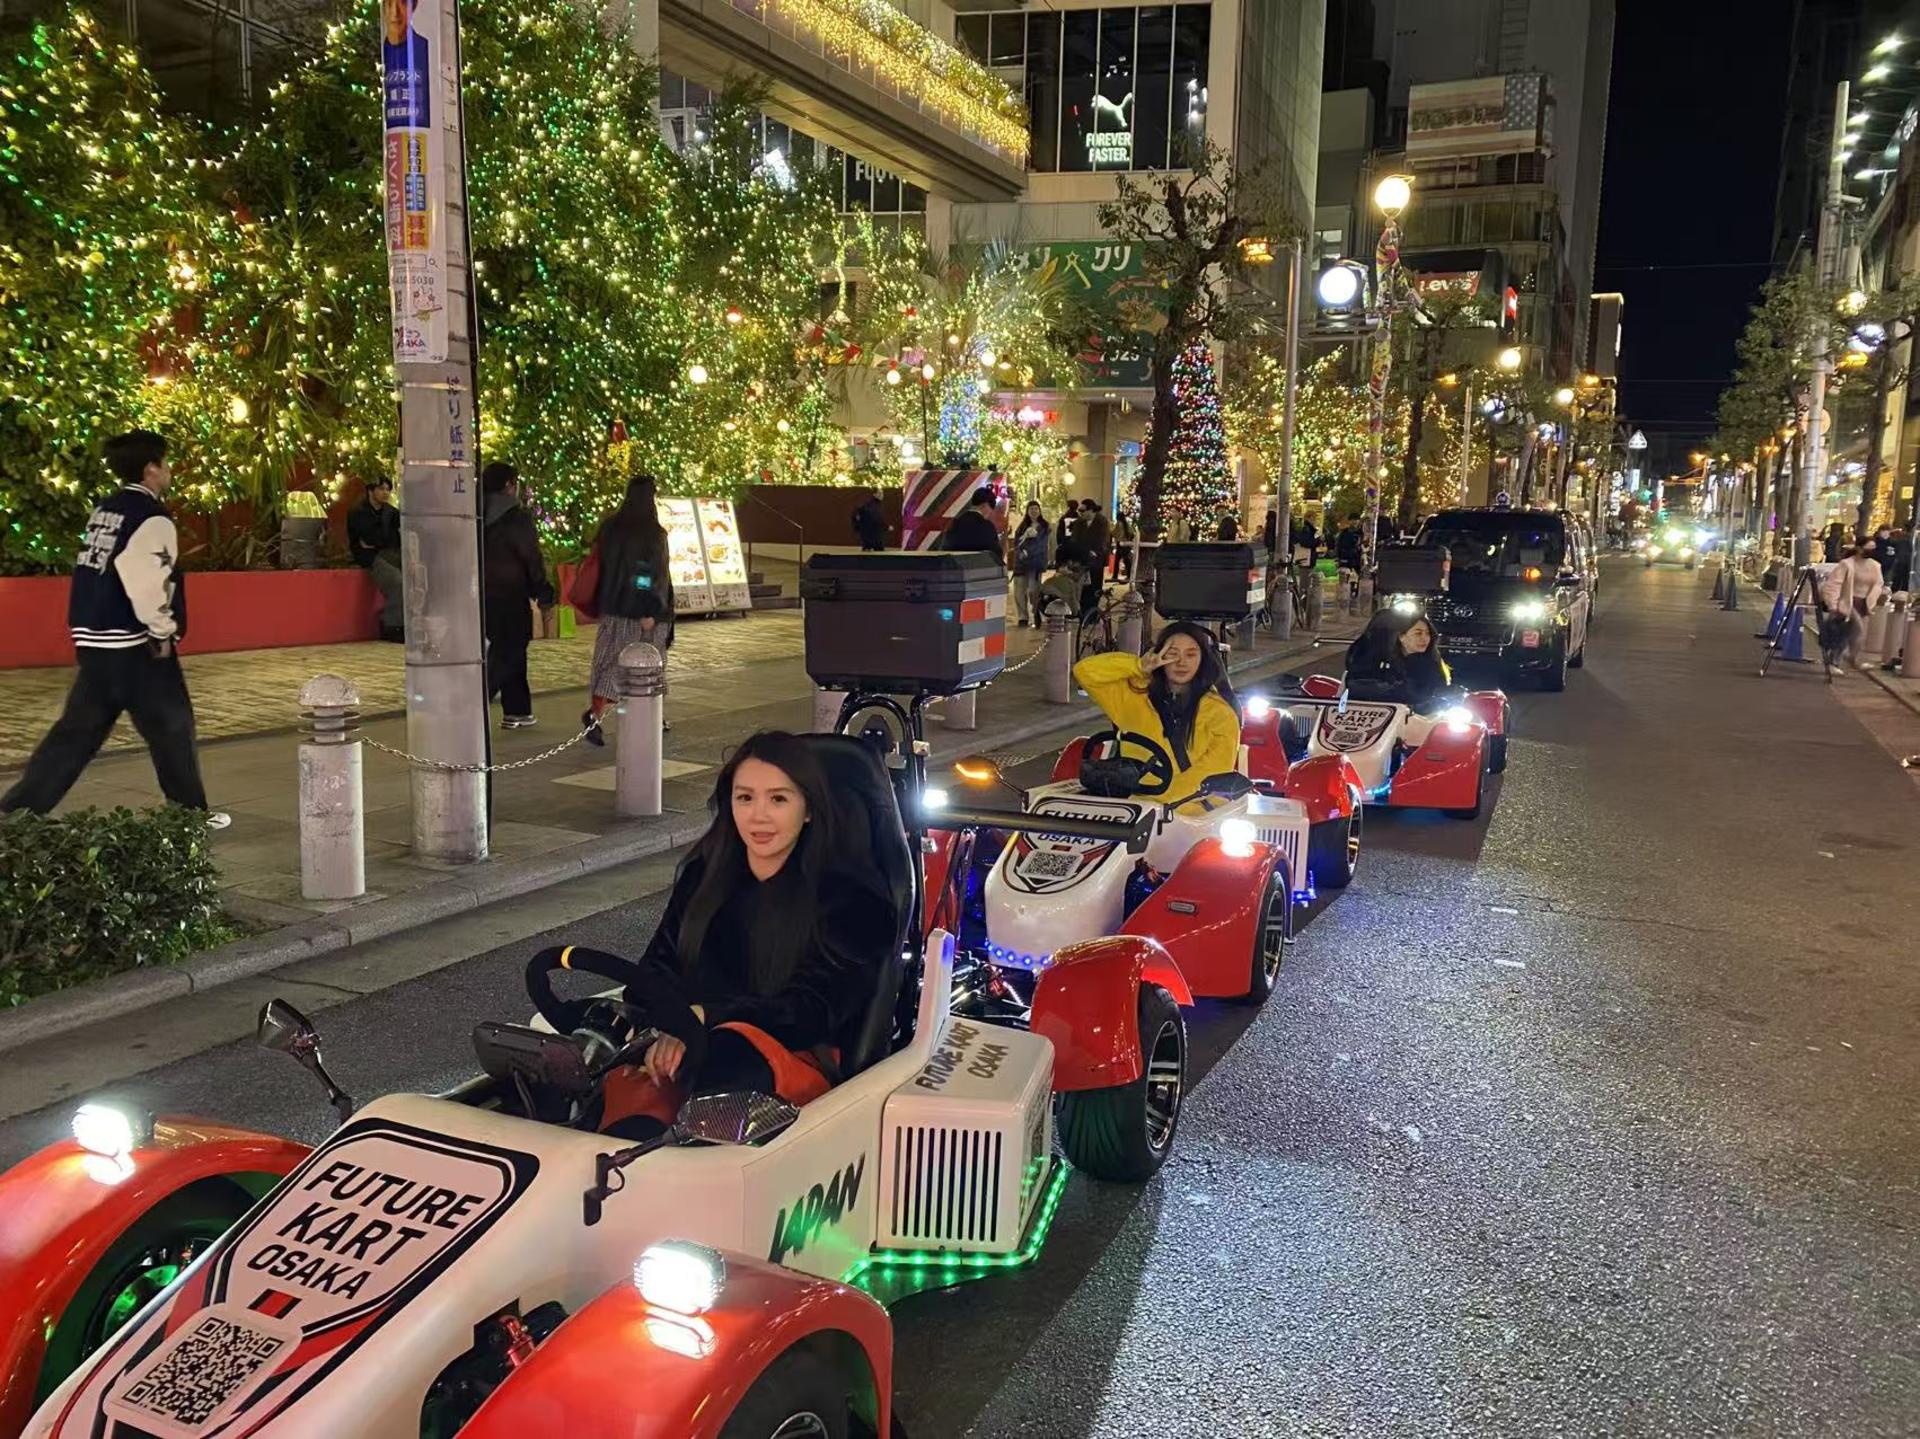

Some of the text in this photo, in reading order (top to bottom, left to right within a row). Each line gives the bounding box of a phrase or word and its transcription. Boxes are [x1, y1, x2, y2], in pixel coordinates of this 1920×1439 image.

[1086, 132, 1132, 148] FOREVER
[1088, 147, 1130, 163] FASTER.
[1334, 714, 1377, 724] KART
[1037, 833, 1095, 846] OSAKA
[914, 1022, 981, 1091] FUTURE KART
[967, 1043, 1009, 1079] OSAKA
[303, 1160, 486, 1231] FUTURE
[275, 1201, 428, 1266] KART
[246, 1244, 372, 1300] OSAKA
